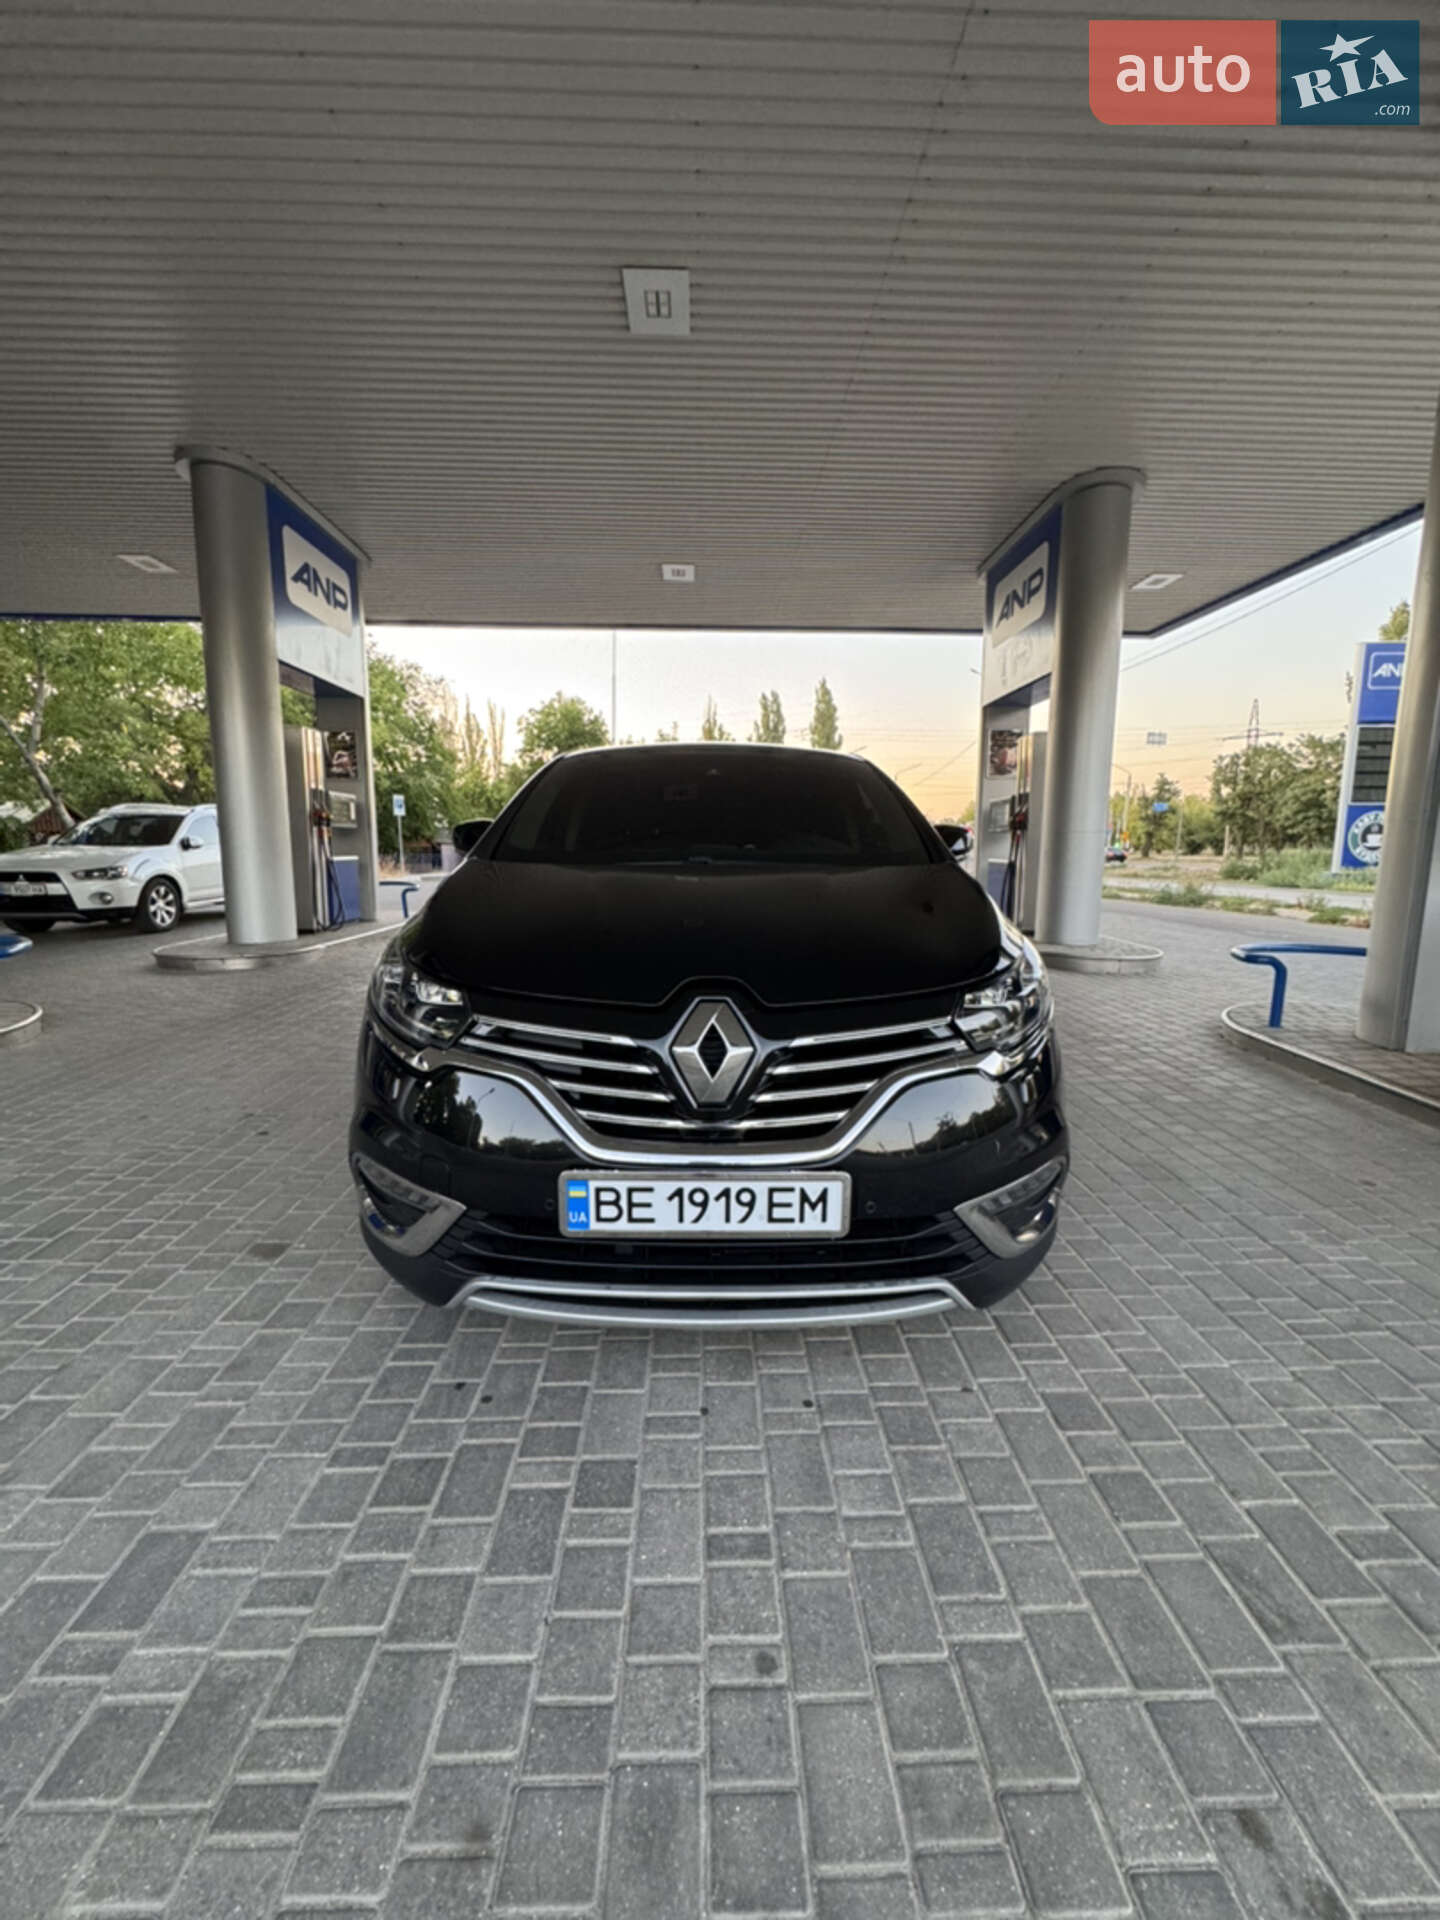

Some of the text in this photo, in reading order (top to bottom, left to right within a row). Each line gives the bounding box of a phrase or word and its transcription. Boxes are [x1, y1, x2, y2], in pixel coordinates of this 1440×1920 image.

[291, 562, 349, 611] ANP
[995, 567, 1045, 629] ANP
[568, 1211, 588, 1223] UA
[594, 1187, 829, 1224] BE 1919 EM
